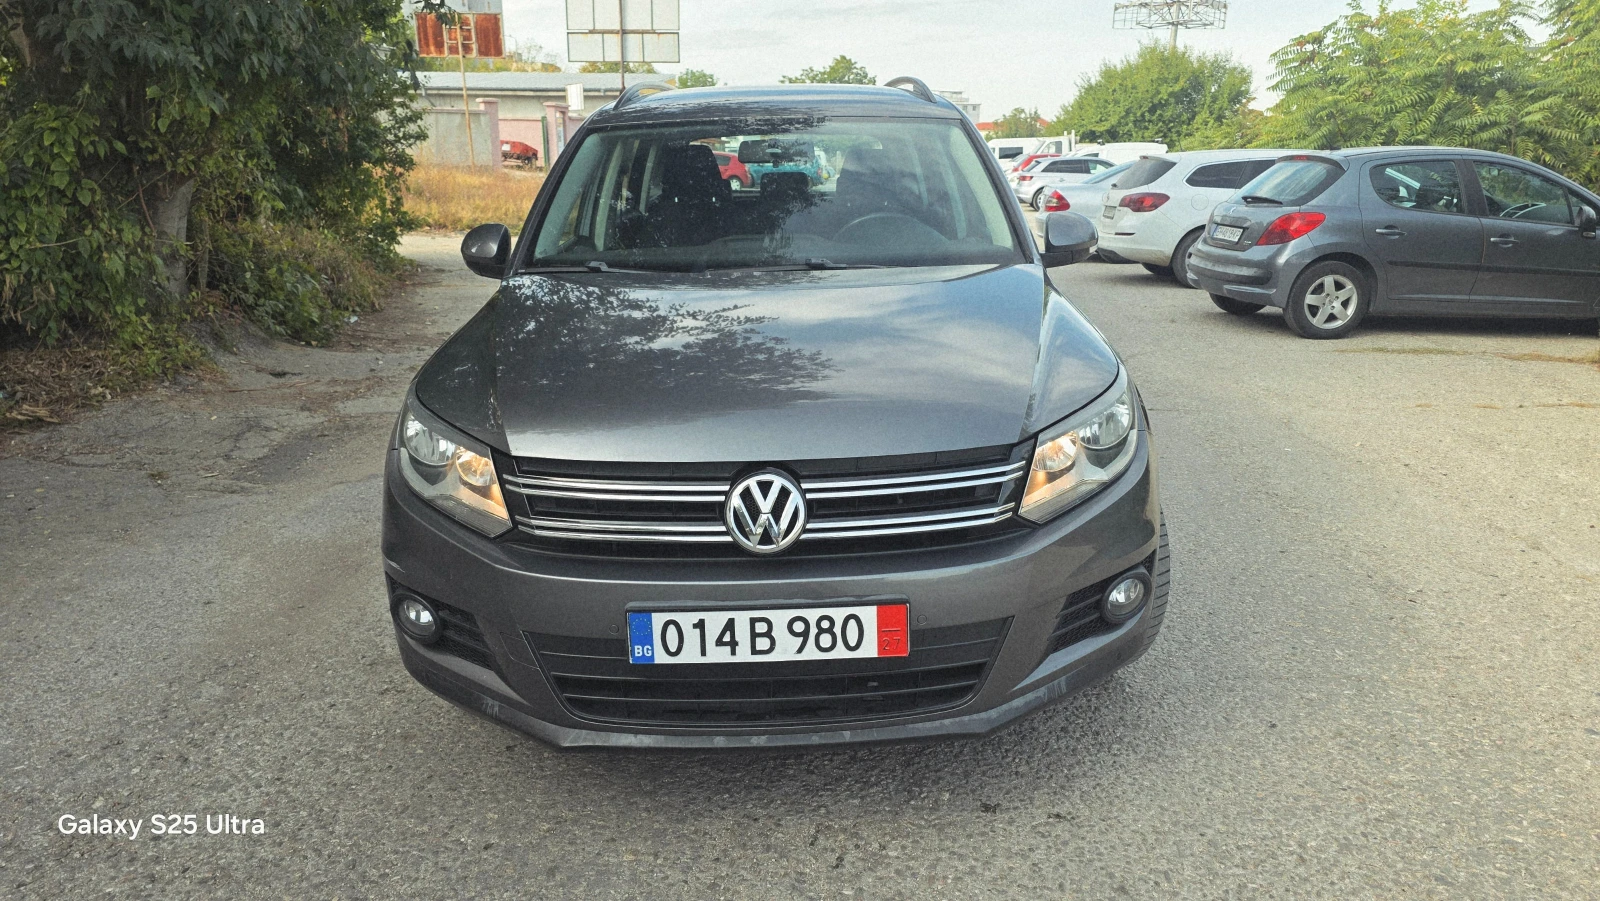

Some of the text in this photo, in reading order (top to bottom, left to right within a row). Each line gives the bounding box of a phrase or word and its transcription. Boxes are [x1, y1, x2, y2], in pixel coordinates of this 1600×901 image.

[730, 475, 801, 550] VW
[882, 636, 901, 651] 27
[634, 646, 652, 657] BG
